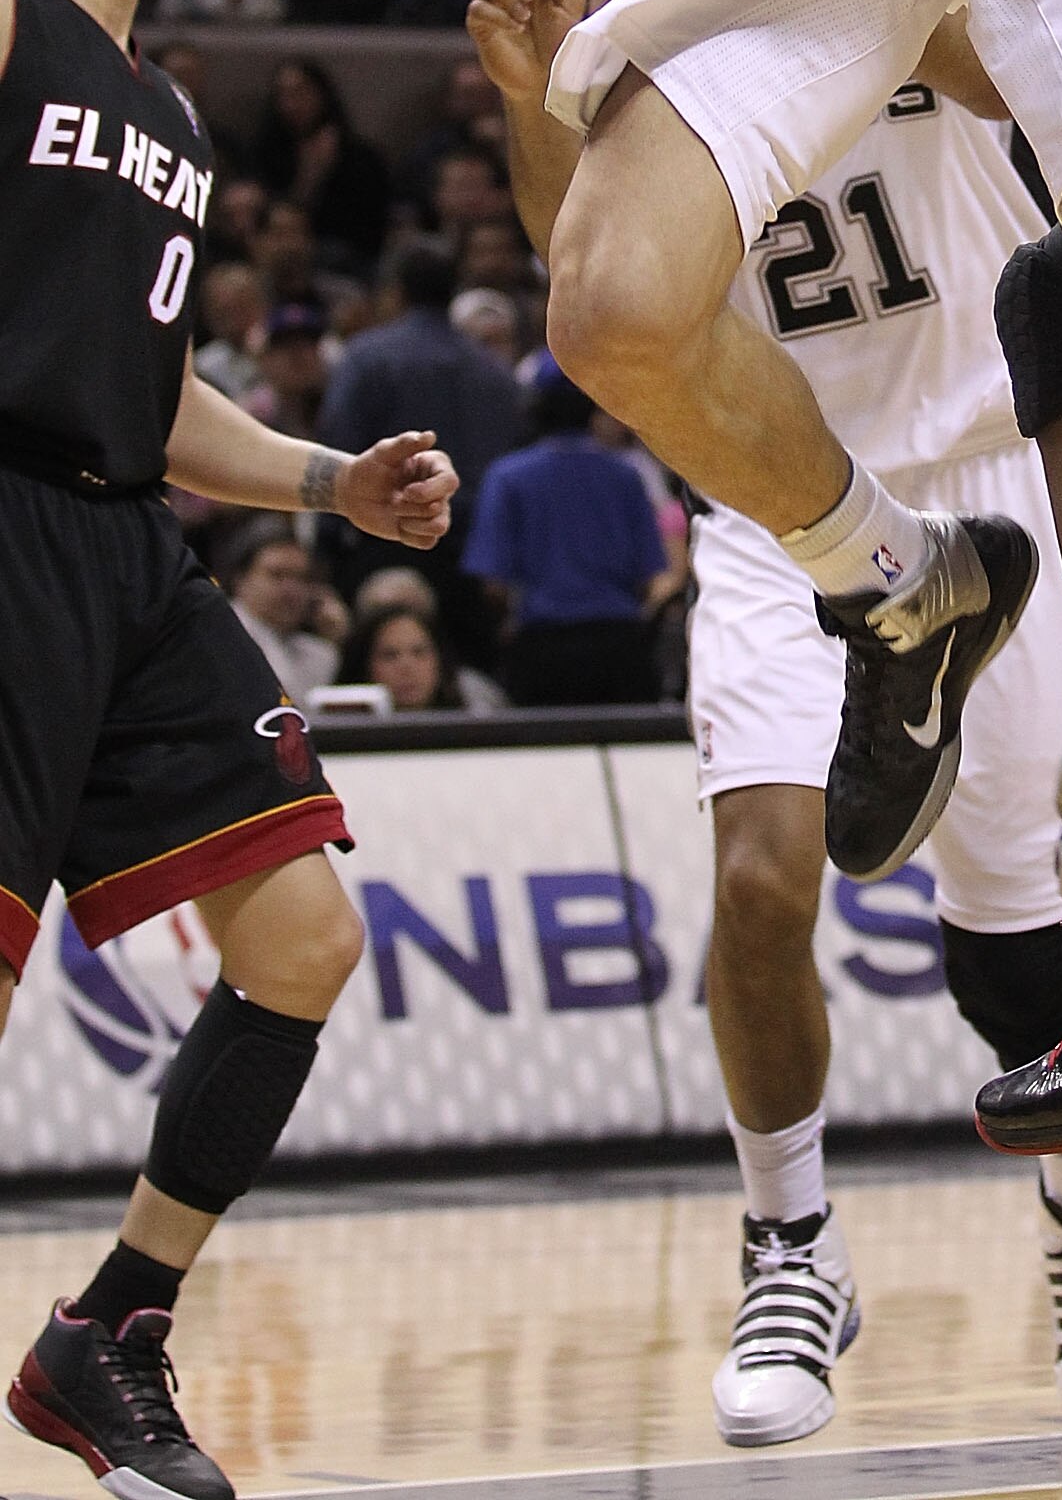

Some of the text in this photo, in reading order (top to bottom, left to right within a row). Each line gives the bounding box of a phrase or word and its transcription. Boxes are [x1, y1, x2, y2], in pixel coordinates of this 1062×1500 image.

[28, 103, 109, 171] EL
[147, 234, 195, 325] 0
[750, 170, 940, 342] 21
